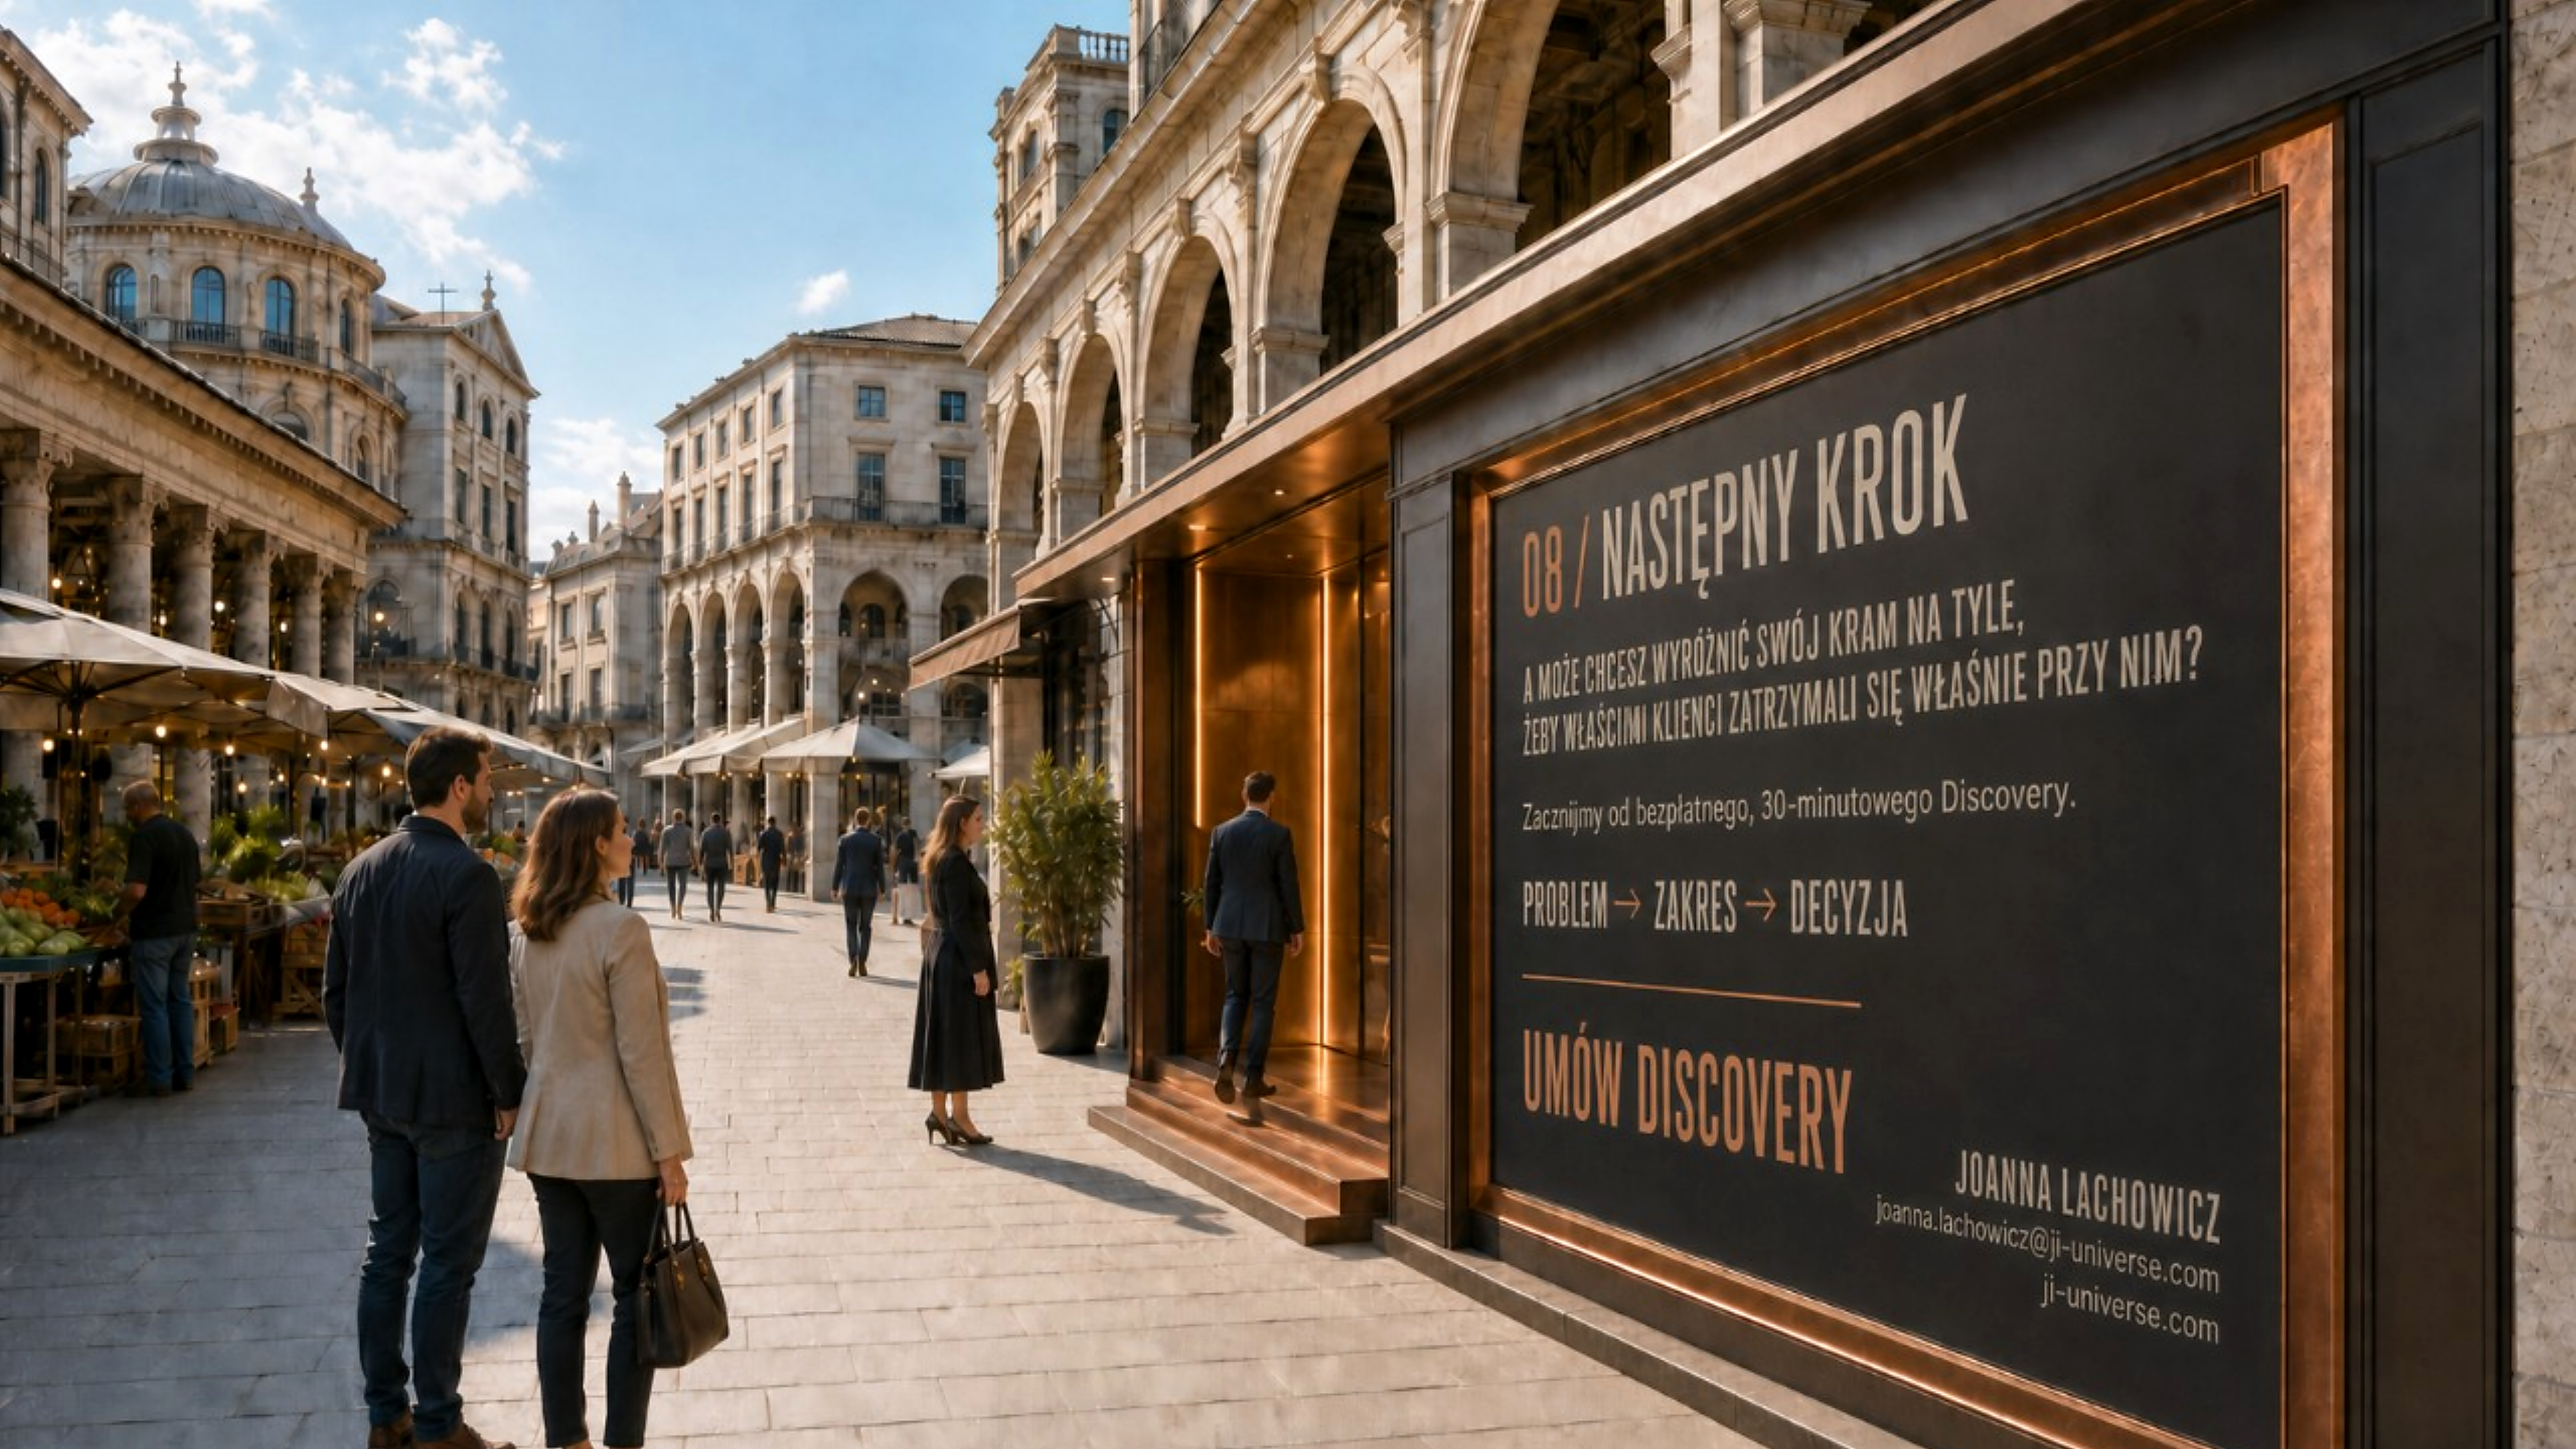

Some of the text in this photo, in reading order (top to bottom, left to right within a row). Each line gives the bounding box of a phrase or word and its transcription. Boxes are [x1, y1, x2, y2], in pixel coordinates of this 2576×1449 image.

[1522, 392, 1969, 618] 08 / NASTĘPNY KROK
[1522, 579, 2024, 705] A MOŻE CHCESZ WYRÓŻNIĆ SWÓJ KRAM NA TYLE,
[1522, 712, 1560, 757] ŻEBY
[1653, 692, 1723, 743] KLIENCI
[1728, 674, 1857, 735] ZATRZYMALI
[1866, 667, 1904, 727] SIĘ
[1911, 648, 2027, 713] WŁAŚNIE
[2038, 638, 2110, 700] PRZY
[2120, 624, 2203, 689] NIM?
[1522, 778, 2076, 837] Zacznijmy od bezpłatnego, 30-minutowego Discovery.
[1523, 878, 1908, 938] PROBLEM ZAKRES DECYZJA
[1524, 1021, 1852, 1175] UMÓW DISCOVERY
[1875, 1194, 2219, 1294] joanna.lachowicz@ji-universe.com
[1955, 1150, 2221, 1245] JOANNA LACHOWICZ
[2040, 1274, 2219, 1344] ji-universe.com
